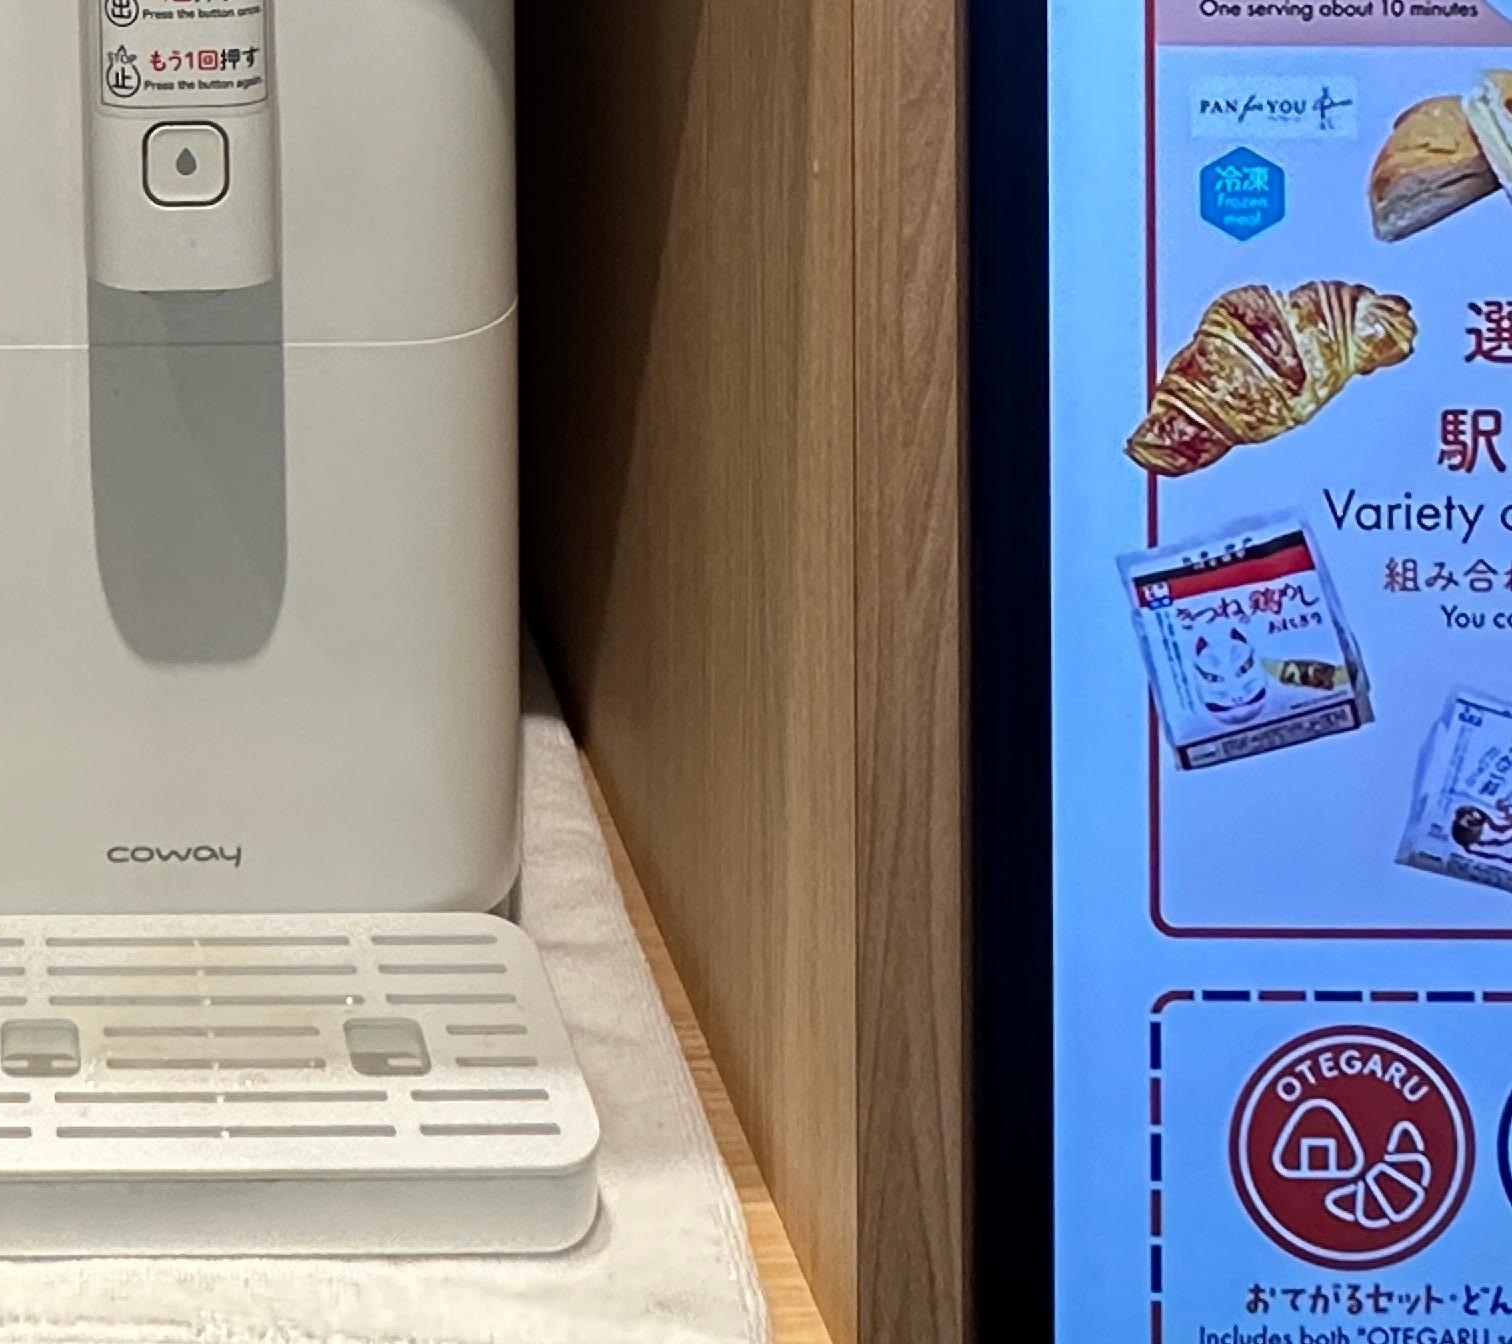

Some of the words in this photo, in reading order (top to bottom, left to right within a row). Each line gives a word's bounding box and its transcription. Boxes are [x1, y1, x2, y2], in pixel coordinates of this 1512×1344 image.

[143, 9, 175, 20] Press
[176, 8, 195, 20] the
[198, 7, 236, 19] button
[1247, 0, 1313, 22] serving
[1409, 0, 1479, 18] minutes
[149, 45, 260, 73] もう1回押す
[112, 66, 134, 90] 止
[144, 79, 175, 91] Press
[177, 79, 196, 90] the
[198, 78, 235, 90] button
[1200, 98, 1239, 114] PAN
[1266, 99, 1307, 115] YOU
[1214, 164, 1270, 193] 冷凍
[1436, 408, 1507, 474] 駅
[1322, 487, 1485, 545] Variety
[1384, 556, 1512, 593] 組み合
[1440, 604, 1486, 629] You
[105, 845, 243, 868] coway
[1276, 1048, 1430, 1105] OTEGARU
[1199, 1324, 1290, 1344] Includes
